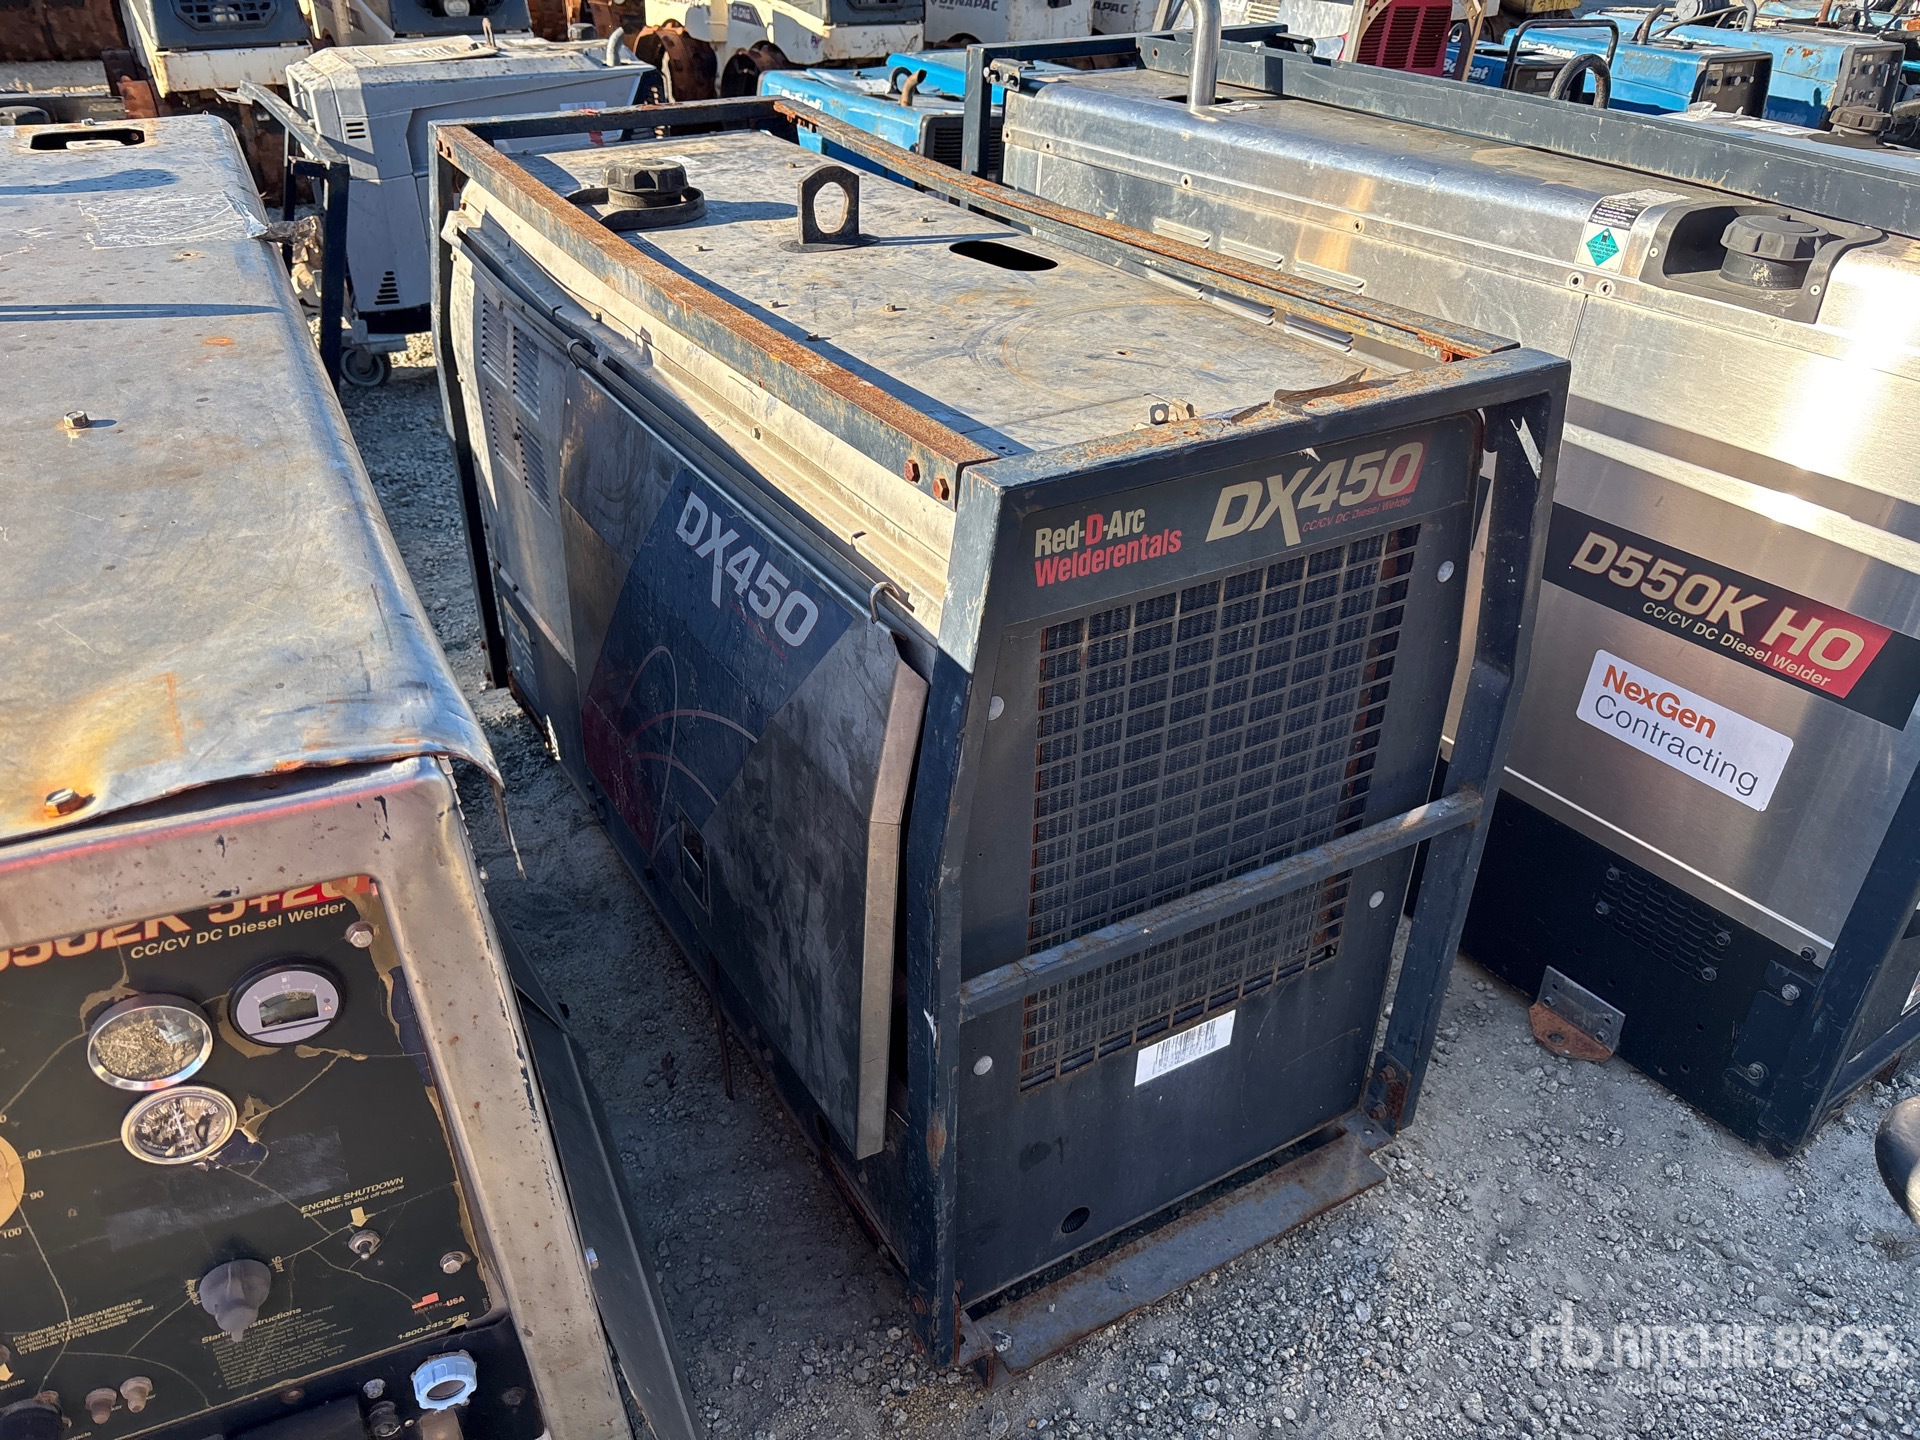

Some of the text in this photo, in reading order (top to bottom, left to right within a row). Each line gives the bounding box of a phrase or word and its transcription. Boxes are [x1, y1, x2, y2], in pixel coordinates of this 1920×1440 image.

[1205, 441, 1424, 547] DX450
[1302, 497, 1413, 533] CC/CV DC Diesel Welder
[1035, 508, 1145, 558] Red-D-Arc
[1035, 528, 1183, 588] Welderentals
[676, 491, 818, 647] DX450
[1570, 531, 1865, 671] D550K HO
[1642, 601, 1832, 688] CC/CV DC Diesel Welder
[1602, 664, 1717, 739] NexGen
[1595, 695, 1758, 797] Contracting
[130, 901, 347, 960] CC/CV DC Diesel Welder
[30, 1190, 44, 1200] 90
[301, 1176, 404, 1214] ENGINE SHUTDOWN
[303, 1209, 323, 1219] Push
[323, 1203, 344, 1213] down
[353, 1195, 369, 1203] shut
[370, 1191, 381, 1199] off
[380, 1184, 405, 1196] engine
[3, 1227, 22, 1239] 100
[12, 1334, 26, 1342] For
[57, 1298, 143, 1328] VOLTAGE/AMPERAGE
[127, 1304, 154, 1318] control
[446, 1295, 466, 1307] USA
